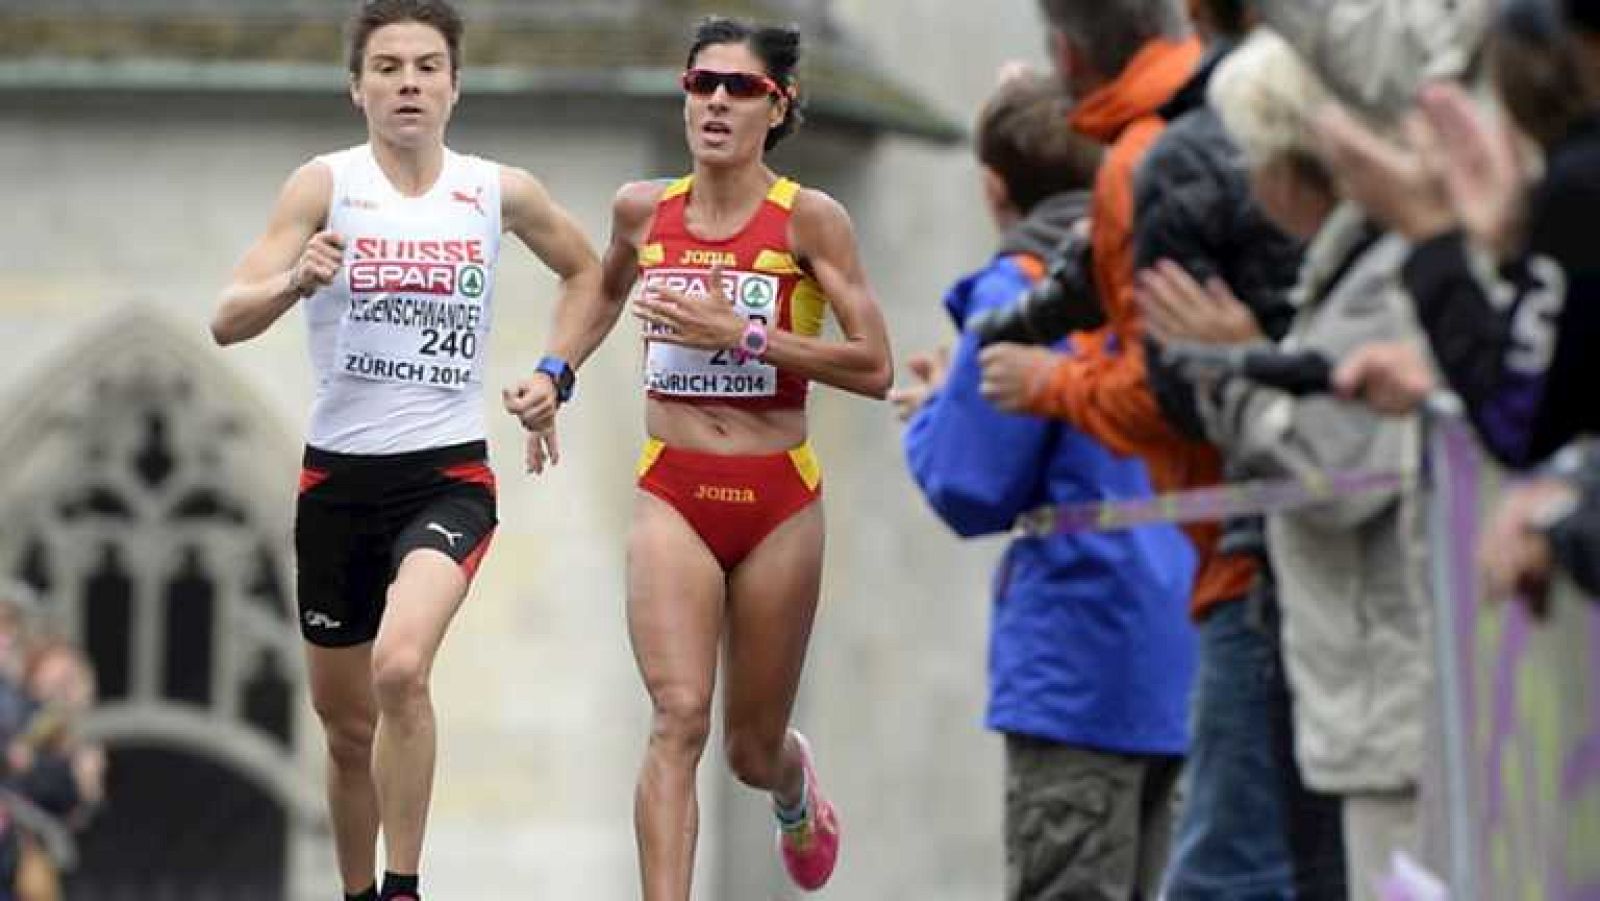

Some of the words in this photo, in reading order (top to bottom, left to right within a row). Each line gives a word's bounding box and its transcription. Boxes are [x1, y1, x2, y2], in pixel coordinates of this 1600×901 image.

[354, 239, 484, 263] SUISSE
[353, 267, 451, 289] SPAR
[419, 329, 476, 359] 240
[345, 353, 424, 379] ZÜRICH
[429, 366, 470, 384] 2014
[723, 375, 764, 392] 2014
